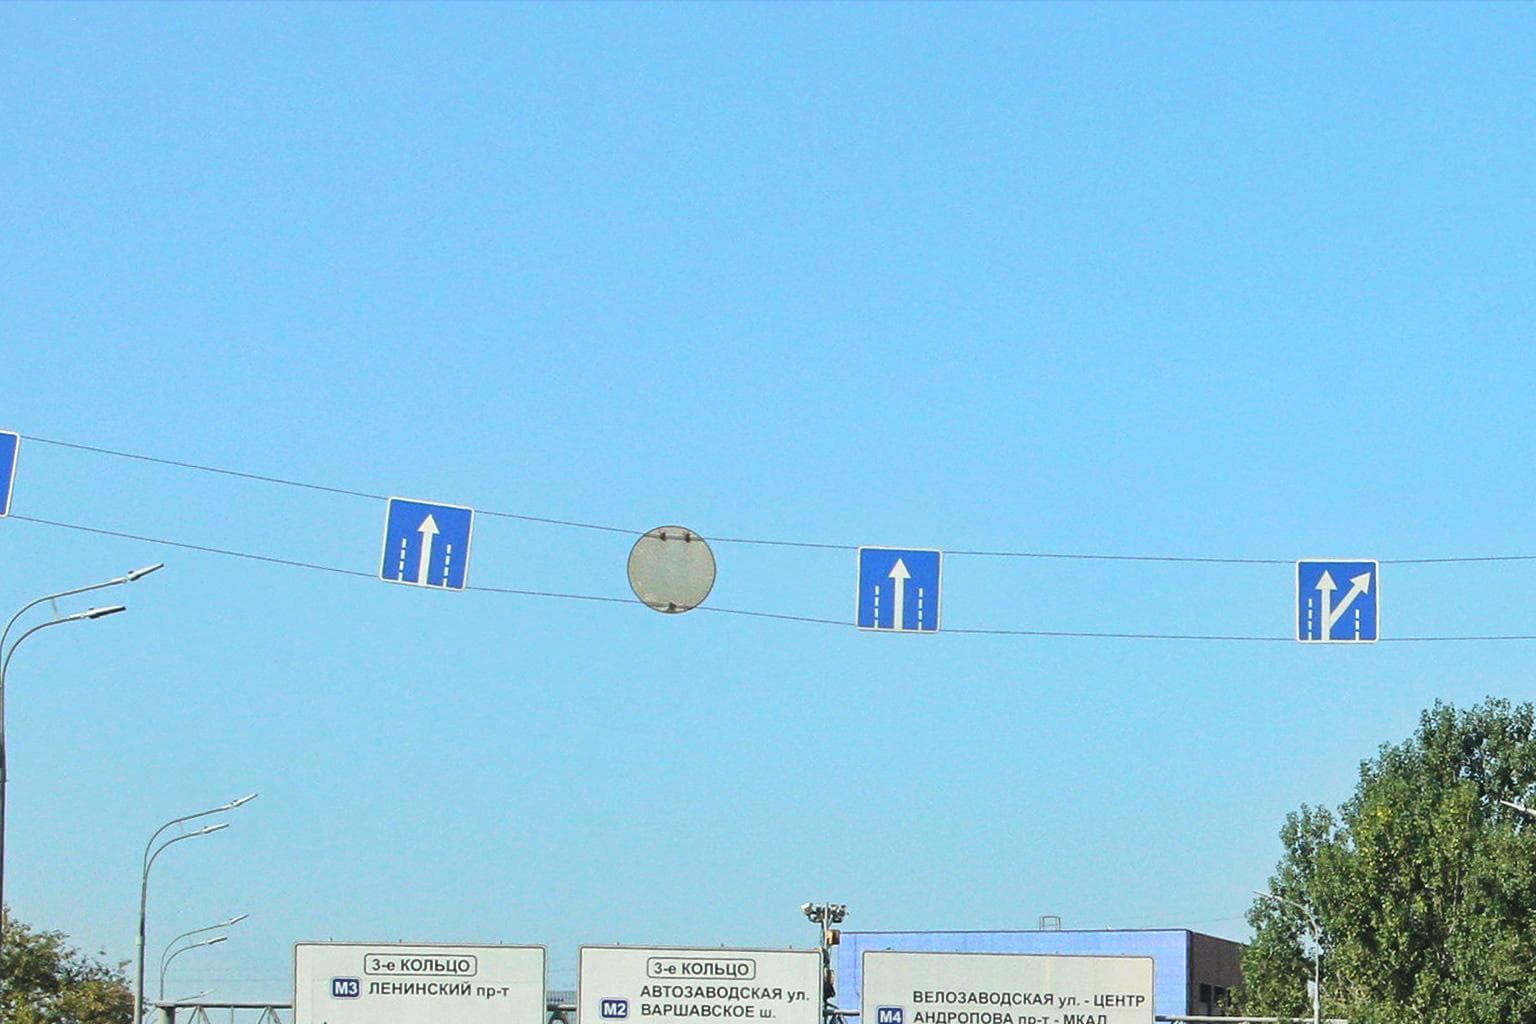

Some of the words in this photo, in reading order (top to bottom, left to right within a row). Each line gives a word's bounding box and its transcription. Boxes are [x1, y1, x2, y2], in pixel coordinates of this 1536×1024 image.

[372, 959, 396, 972] 3-е
[400, 959, 470, 974] КОЛЬЦО
[653, 962, 677, 975] 3-е
[681, 963, 749, 977] КОЛЬЦО
[334, 979, 358, 995] М3
[369, 980, 472, 996] ЛЕНИНСКИЙ
[476, 985, 510, 999] пр-т
[640, 985, 782, 1000] АВТОЗАВОДСКАЯ
[787, 990, 810, 1003] ул.
[913, 990, 1054, 1007] ВЕЛОЗАВОДСКАЯ
[1058, 994, 1080, 1009] ул.
[1094, 995, 1145, 1010] ЦЕНТР
[603, 1003, 626, 1017] М2
[641, 1004, 755, 1018] ВАРШАВСКОЕ
[759, 1008, 776, 1018] ш.
[879, 1010, 902, 1024] М4
